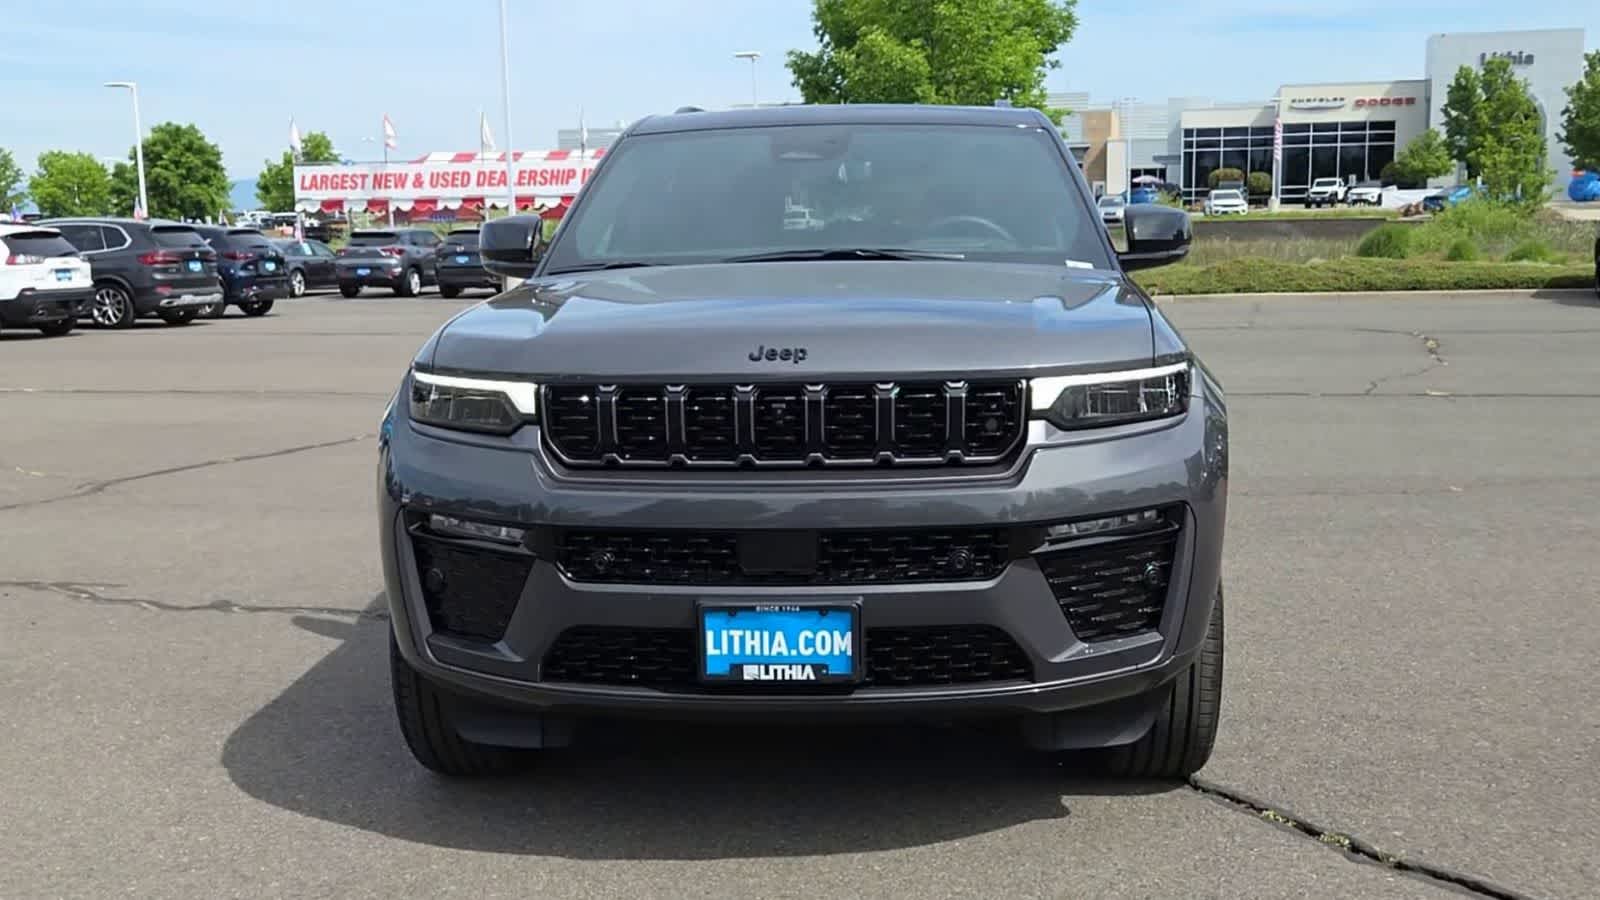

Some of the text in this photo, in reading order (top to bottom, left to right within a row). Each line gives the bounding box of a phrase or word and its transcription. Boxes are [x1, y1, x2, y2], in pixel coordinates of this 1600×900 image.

[1354, 97, 1417, 108] DODGE
[300, 174, 368, 191] LARGEST
[372, 172, 408, 190] NEW
[412, 172, 424, 188] &
[429, 171, 471, 188] USED
[476, 168, 577, 187] DEAERSHIP
[748, 345, 807, 364] Jeep
[705, 629, 853, 657] LITHIA.COM
[760, 664, 816, 681] LITHIA
